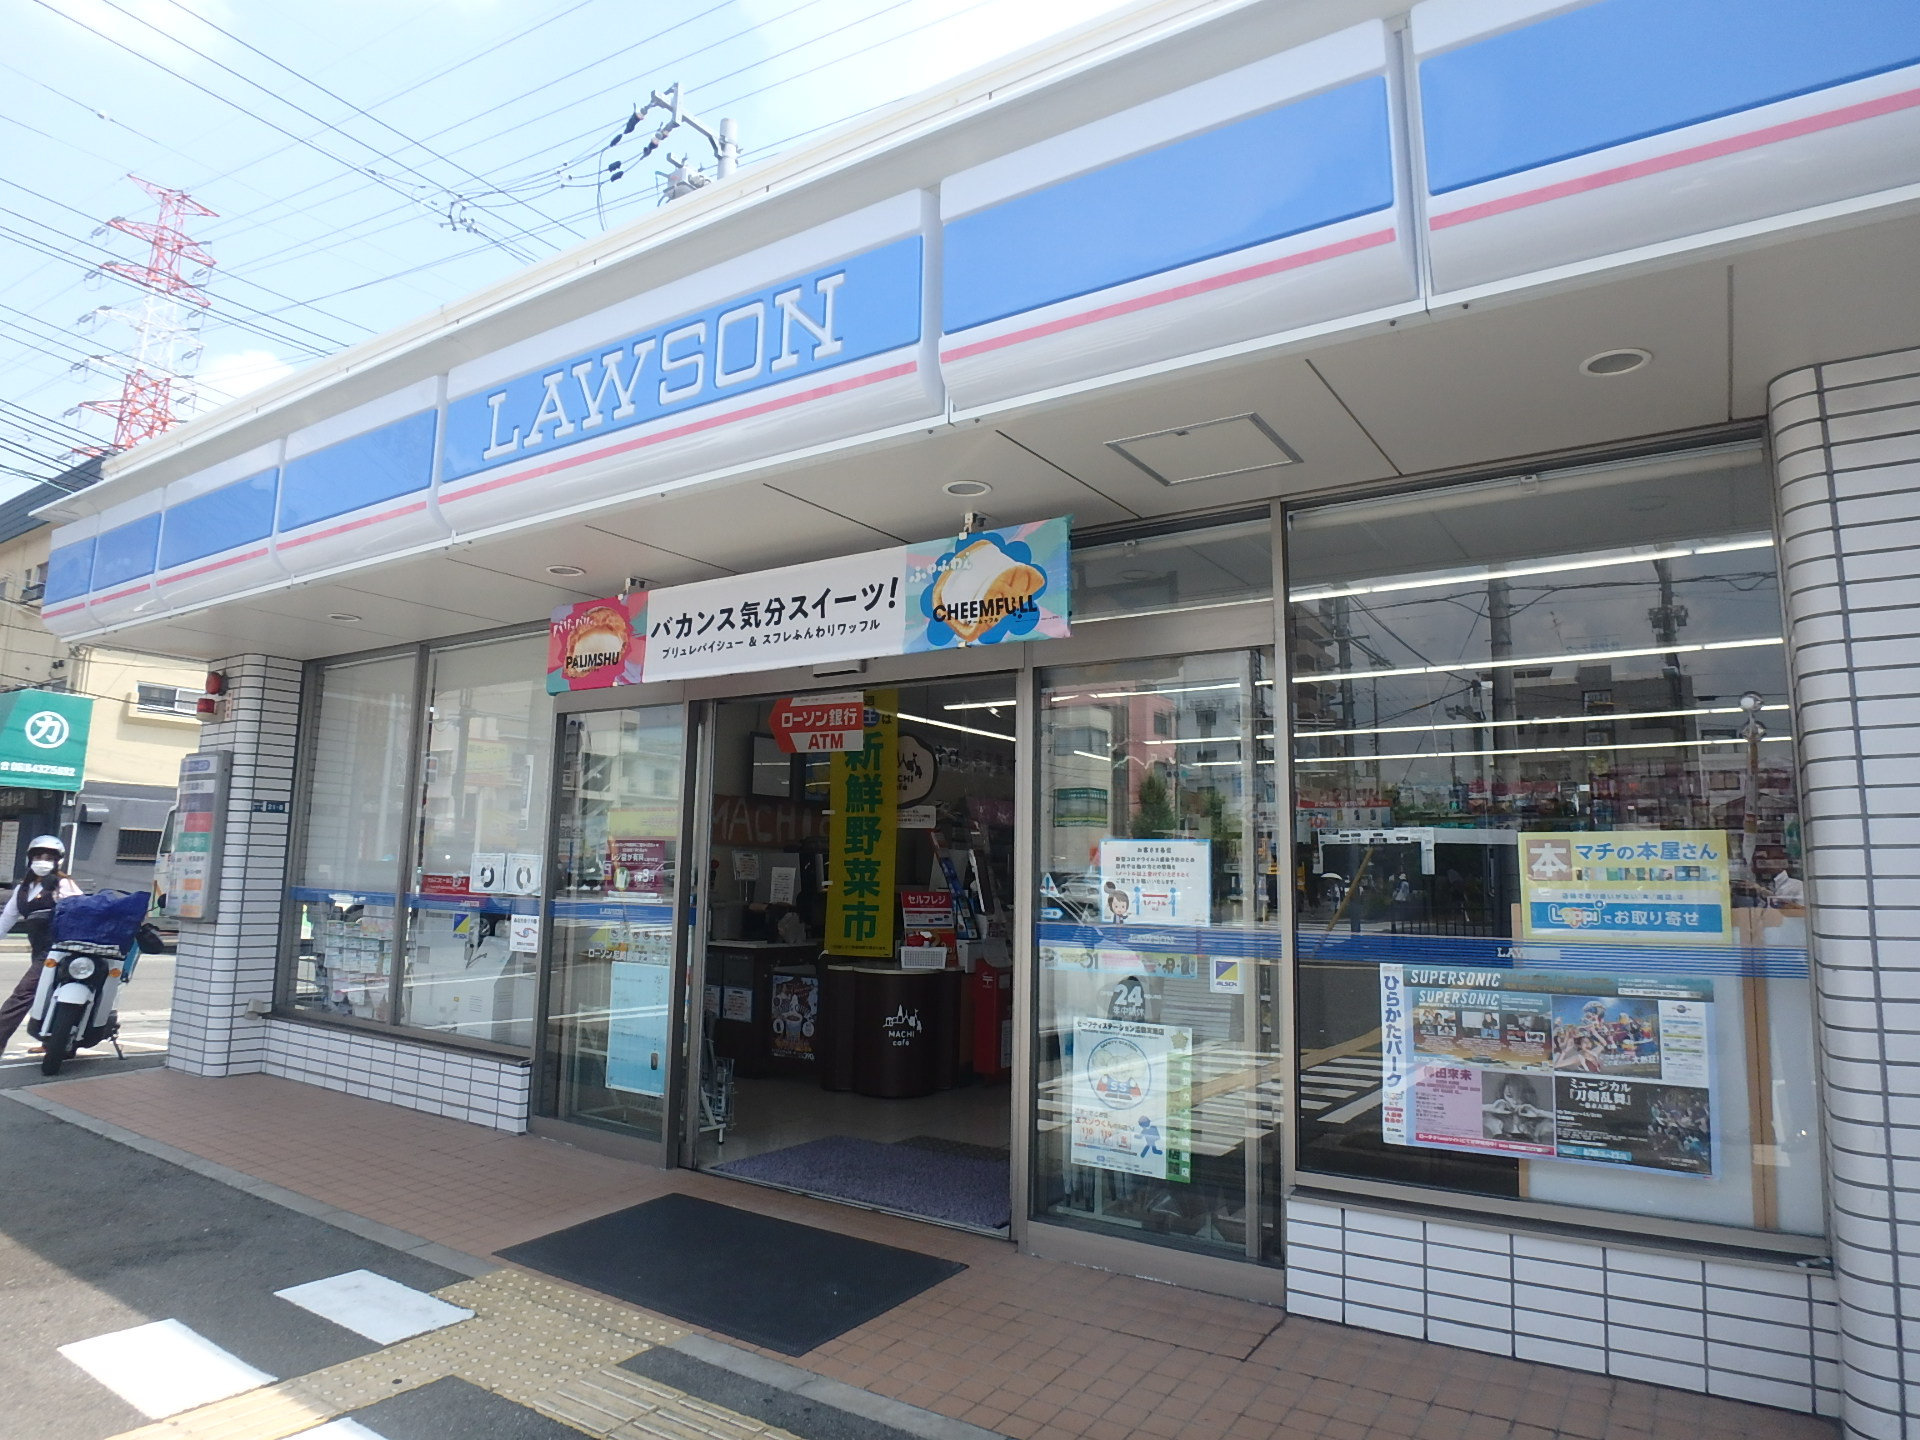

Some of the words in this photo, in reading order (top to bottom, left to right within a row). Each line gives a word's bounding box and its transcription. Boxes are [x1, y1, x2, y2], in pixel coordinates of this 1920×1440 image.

[483, 271, 846, 461] LAWSON
[651, 578, 899, 640] バカンス気分スイーツ!
[932, 595, 1038, 623] CHEEMFULL
[749, 637, 758, 647] &
[762, 619, 881, 646] スフレふんわりワッフル
[781, 708, 858, 728] ローソン銀行
[807, 733, 844, 750] ATM
[842, 731, 884, 942] 新鮮野菜市
[1530, 842, 1568, 878] 本
[1575, 841, 1718, 861] マチの本屋さん
[908, 895, 945, 905] セルフレジ
[1410, 969, 1501, 987] SUPERSONIC
[1113, 983, 1143, 1007] 24
[1419, 990, 1499, 1006] SUPERSONIC
[888, 1030, 915, 1038] MACHI
[1383, 975, 1402, 1088] ひらかたパーク
[1570, 1078, 1632, 1093] ミュージカル
